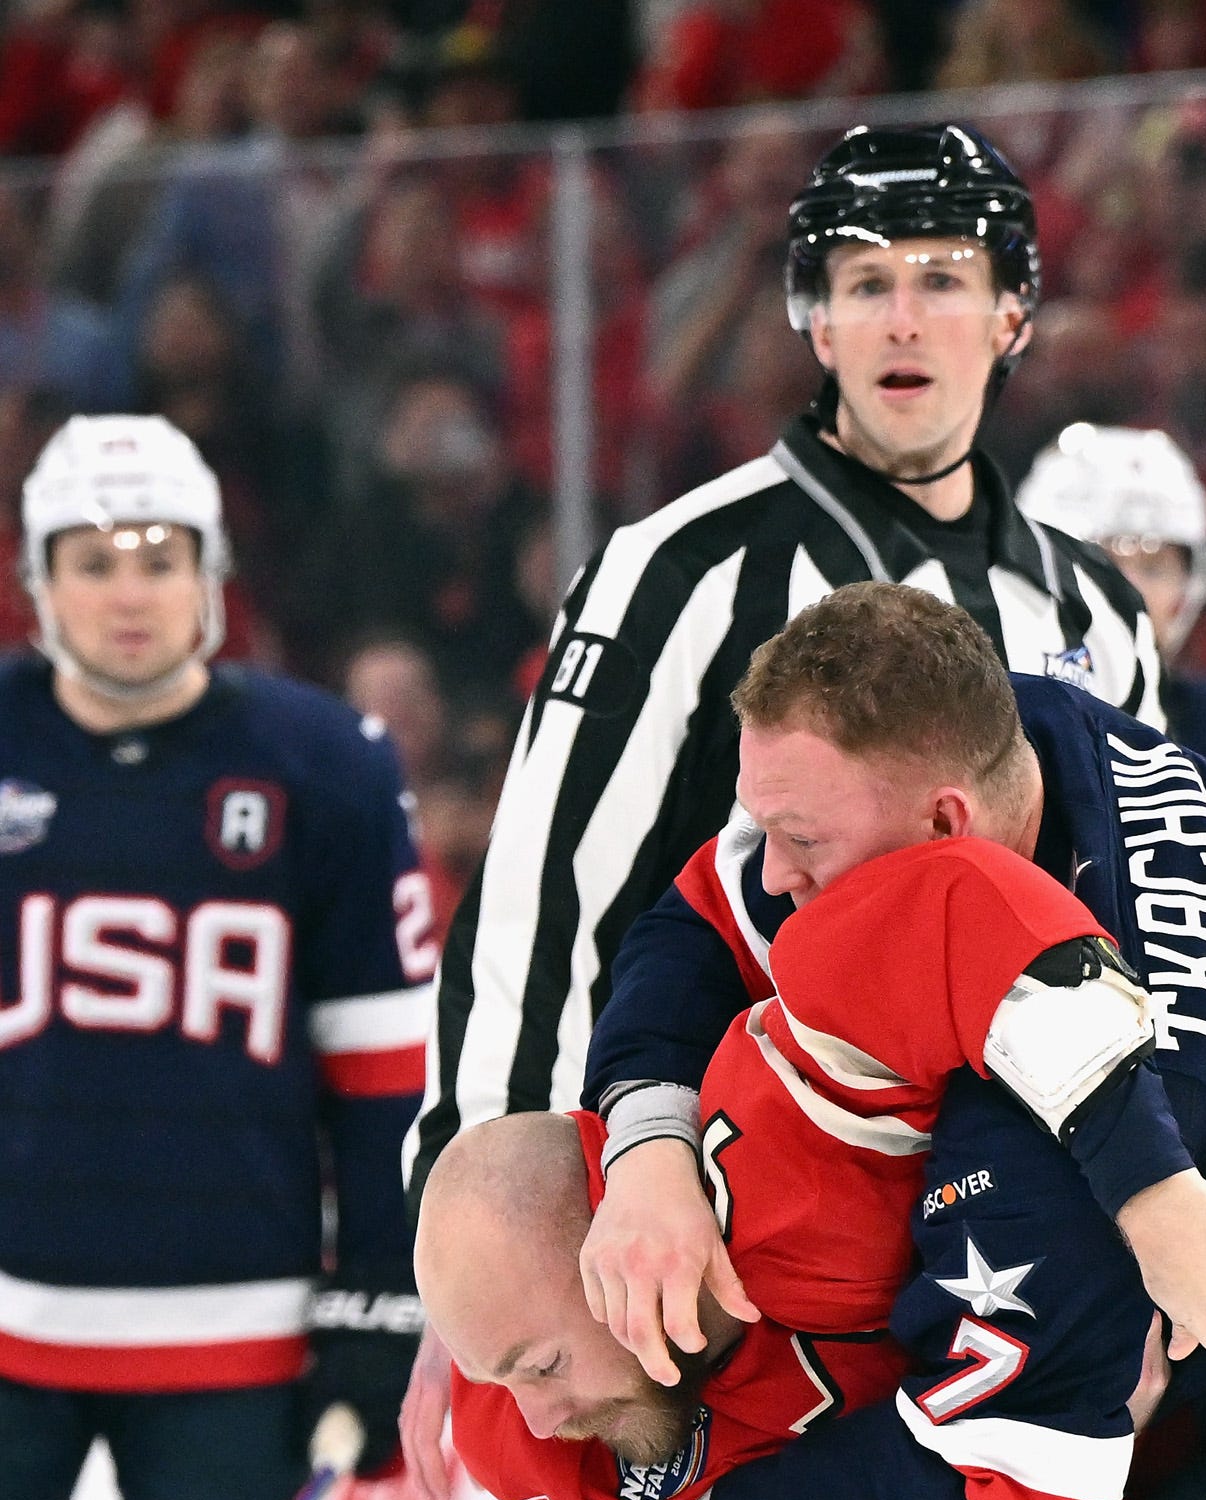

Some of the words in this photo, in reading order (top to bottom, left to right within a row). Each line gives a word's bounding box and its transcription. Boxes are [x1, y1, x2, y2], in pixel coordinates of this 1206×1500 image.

[221, 789, 269, 853] A
[923, 1169, 994, 1220] DSCOVER
[916, 1313, 1030, 1427] 7
